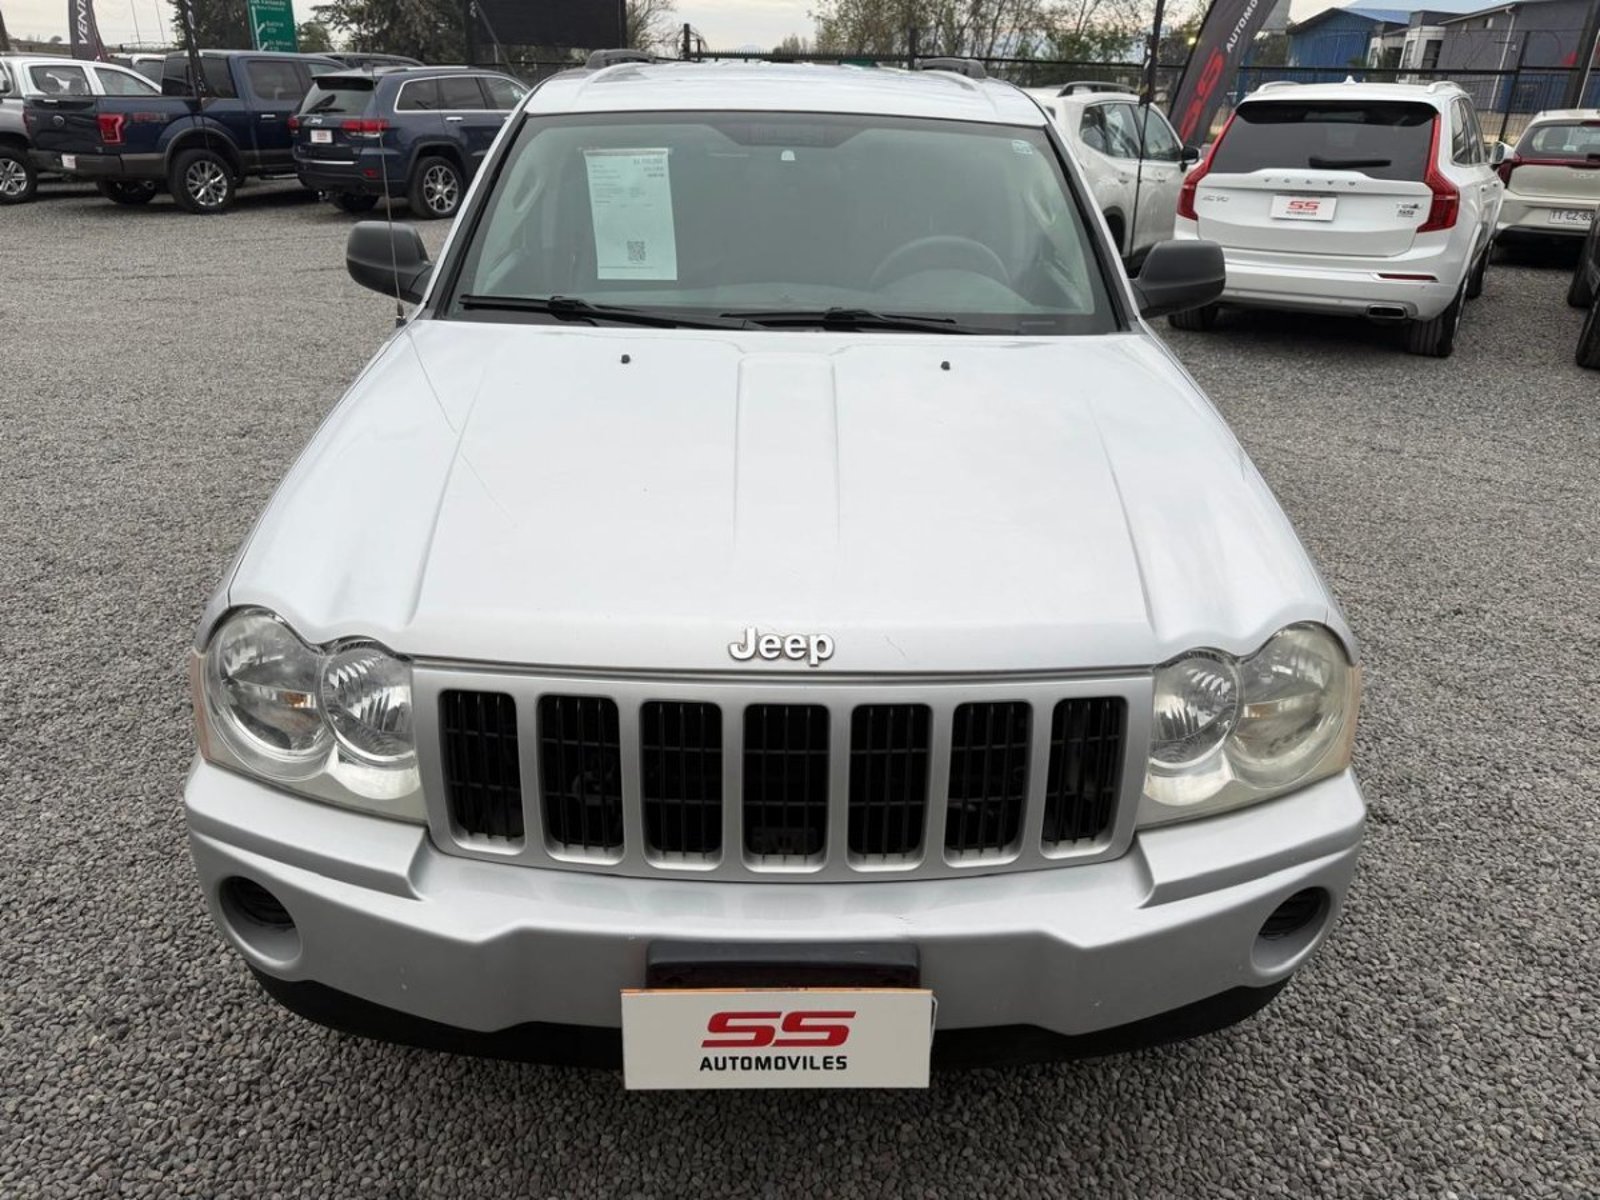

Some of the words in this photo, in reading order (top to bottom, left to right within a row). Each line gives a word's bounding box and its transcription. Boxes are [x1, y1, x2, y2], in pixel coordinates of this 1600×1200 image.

[77, 0, 88, 44] VENT
[1287, 199, 1321, 211] SS
[728, 626, 836, 668] Jeep
[701, 1010, 857, 1049] SS
[699, 1055, 849, 1072] AUTOMOVILES
